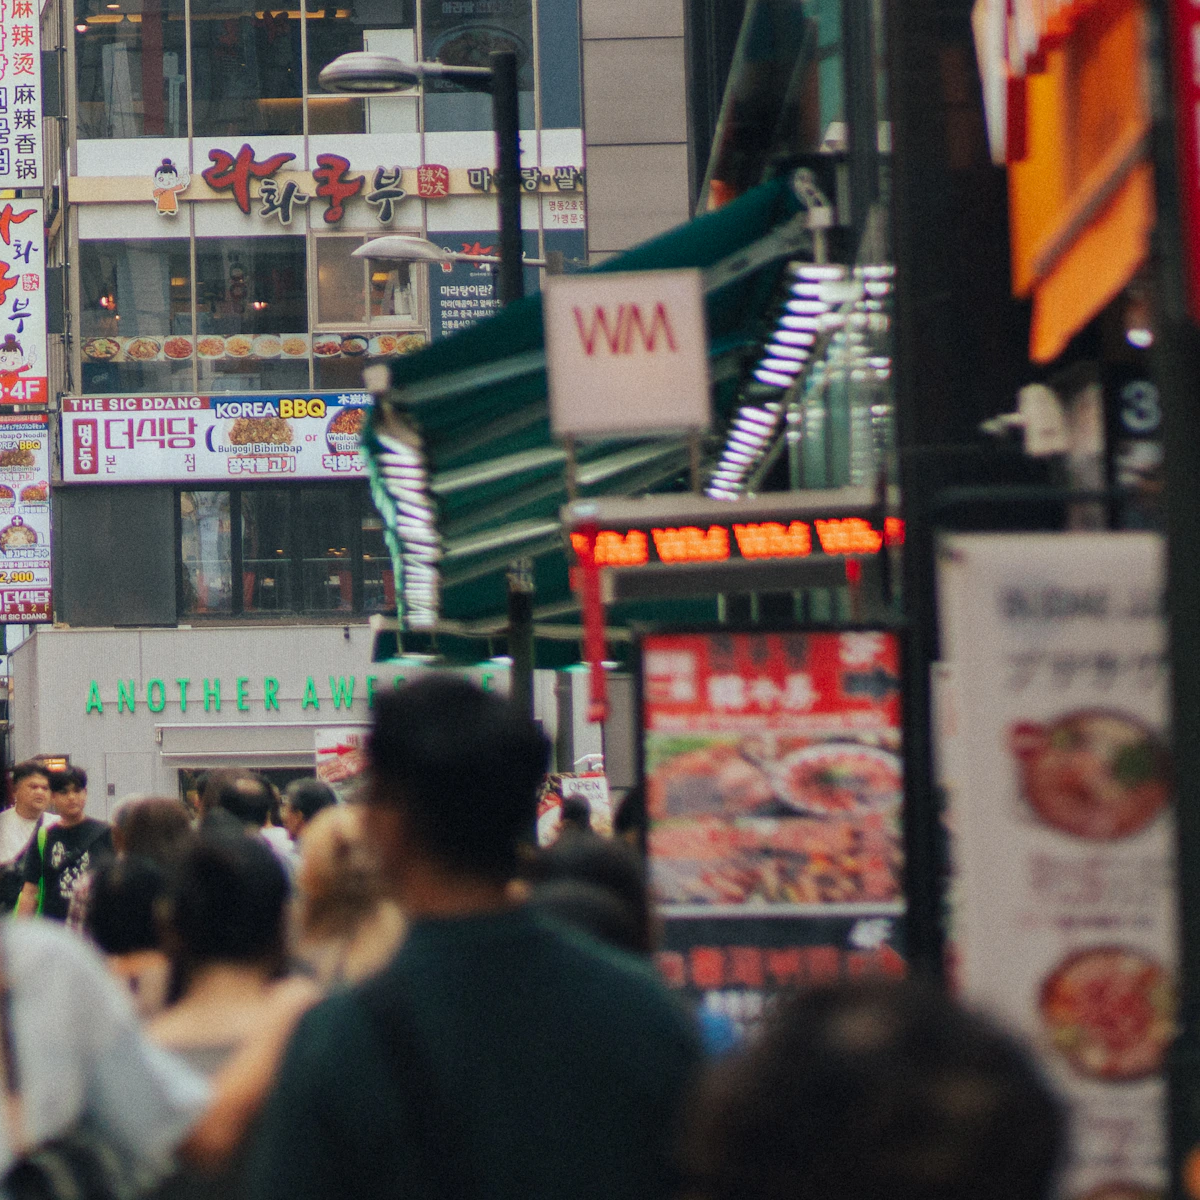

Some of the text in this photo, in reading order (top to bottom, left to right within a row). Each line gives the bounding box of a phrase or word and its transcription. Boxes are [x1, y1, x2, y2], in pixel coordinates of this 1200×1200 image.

[440, 284, 493, 297] 마라탕이란?
[70, 397, 202, 411] THE SIC DDANG
[215, 398, 326, 418] KOREA BBQ
[104, 417, 198, 450] 더식당
[304, 433, 318, 442] or
[19, 440, 41, 450] BBQ
[78, 424, 93, 471] 명동
[218, 444, 303, 455] Bulgogi Bibimbap
[86, 676, 280, 714] ANOTHER
